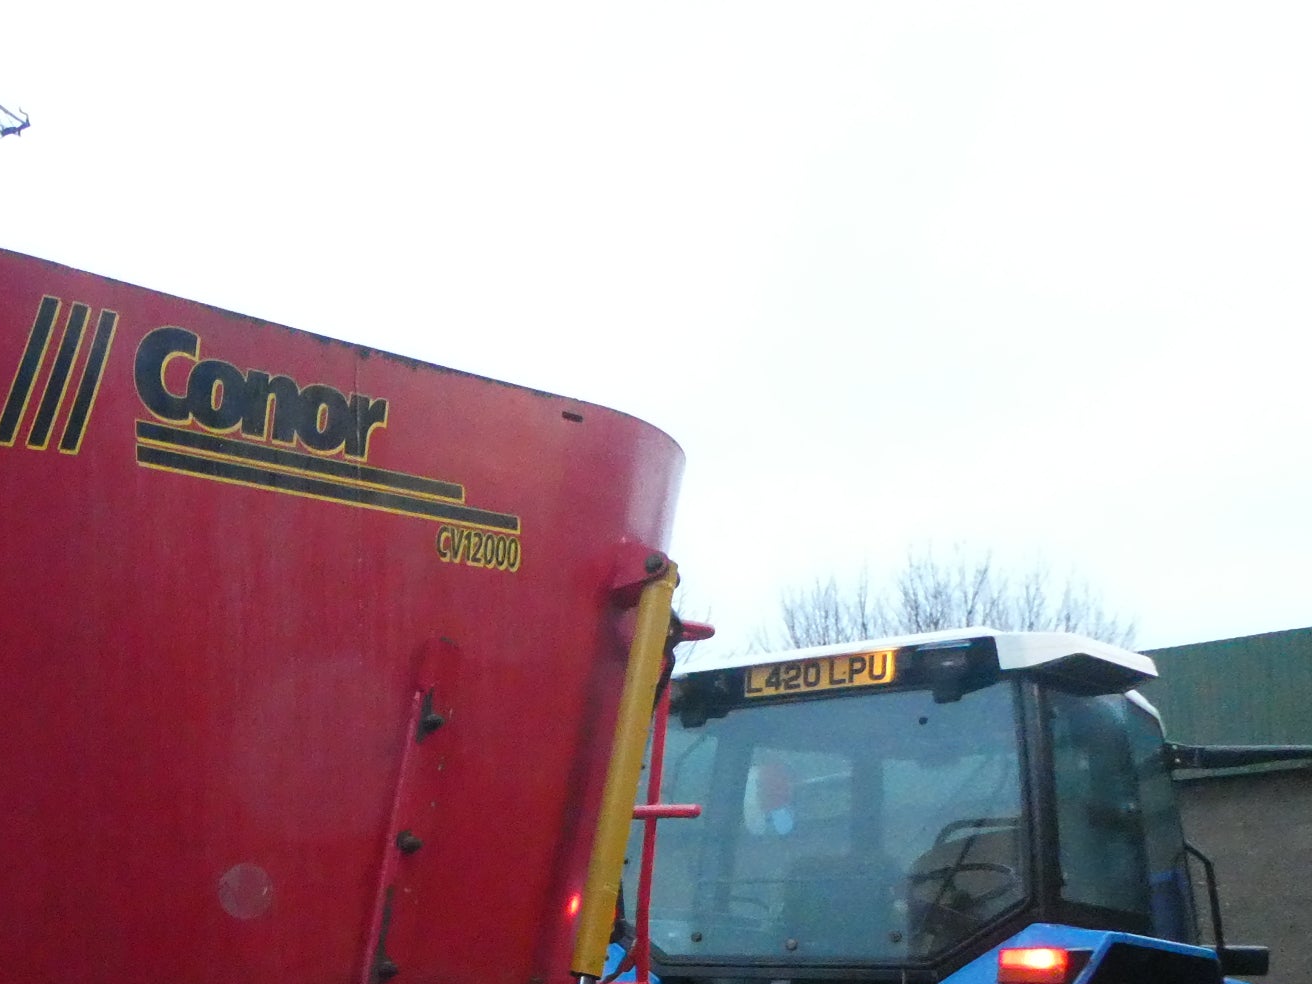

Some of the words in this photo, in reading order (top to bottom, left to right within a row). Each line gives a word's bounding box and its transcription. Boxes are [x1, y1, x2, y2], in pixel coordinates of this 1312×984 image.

[134, 326, 387, 461] Conor
[436, 525, 521, 572] CV12000
[745, 661, 821, 694] L420
[828, 653, 889, 686] LPU
